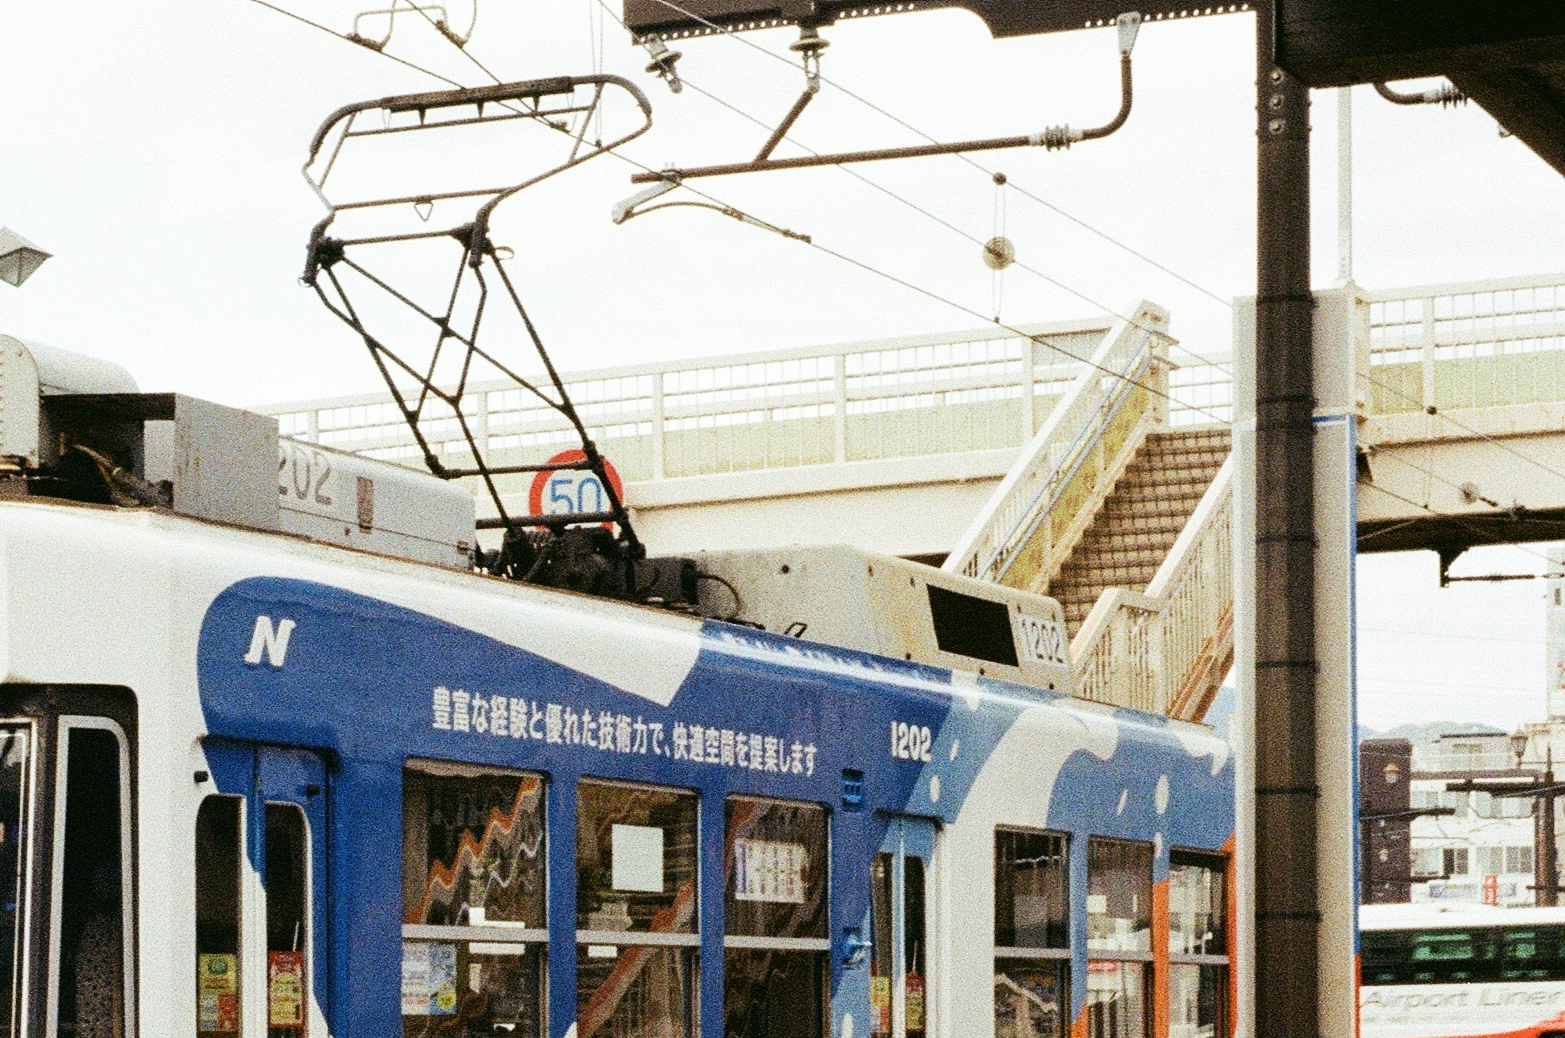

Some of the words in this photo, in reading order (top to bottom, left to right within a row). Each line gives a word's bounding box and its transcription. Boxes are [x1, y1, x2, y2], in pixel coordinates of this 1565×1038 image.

[550, 476, 605, 514] 50
[243, 615, 296, 667] N
[1020, 616, 1065, 665] 1202
[890, 721, 933, 764] 1202
